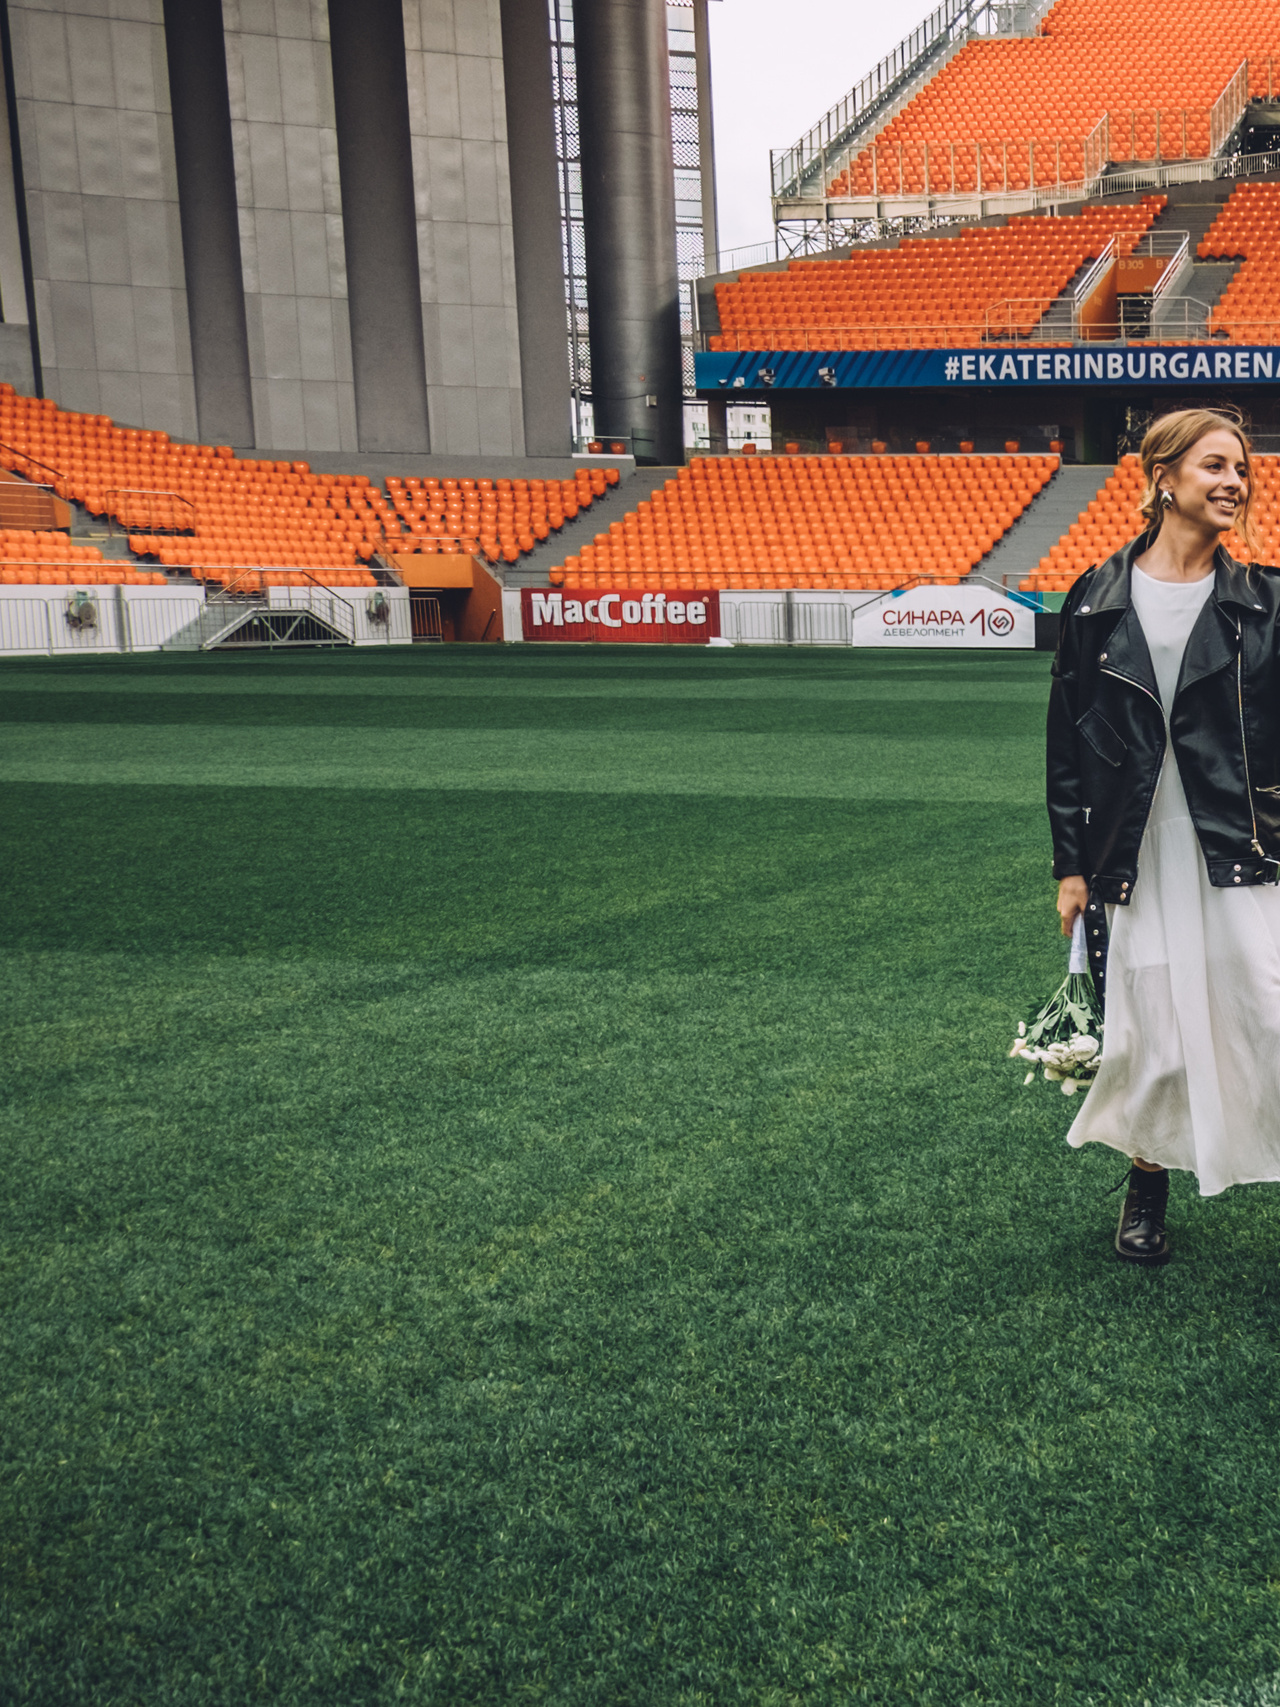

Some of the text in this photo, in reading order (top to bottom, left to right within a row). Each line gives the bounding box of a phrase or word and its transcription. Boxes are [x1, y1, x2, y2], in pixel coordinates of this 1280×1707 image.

[531, 592, 707, 628] MacCoffee
[882, 610, 965, 625] СИНАРА
[883, 628, 966, 637] ДЕВЕЛОПМЕНТ
